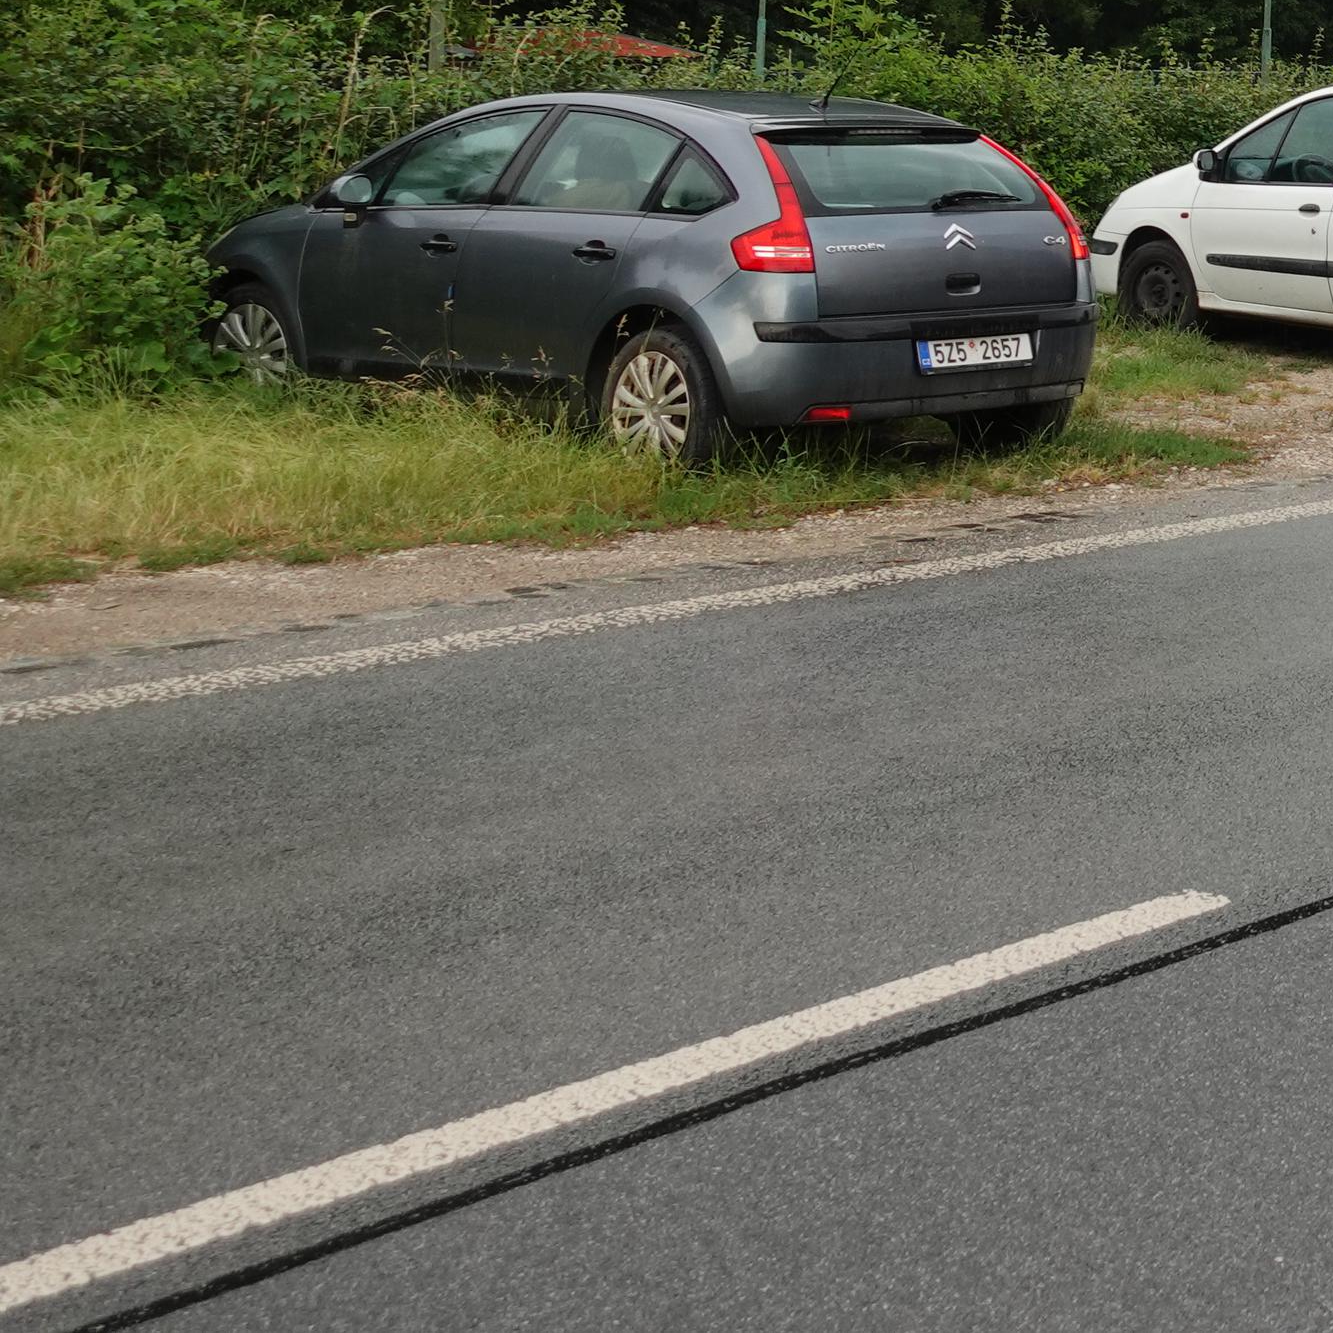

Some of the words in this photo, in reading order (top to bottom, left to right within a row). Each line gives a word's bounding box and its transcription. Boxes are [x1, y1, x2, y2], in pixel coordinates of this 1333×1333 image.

[1043, 235, 1066, 245] C4
[825, 242, 886, 254] CITROËN
[933, 341, 967, 364] 5Z5
[980, 337, 1021, 360] 2657
